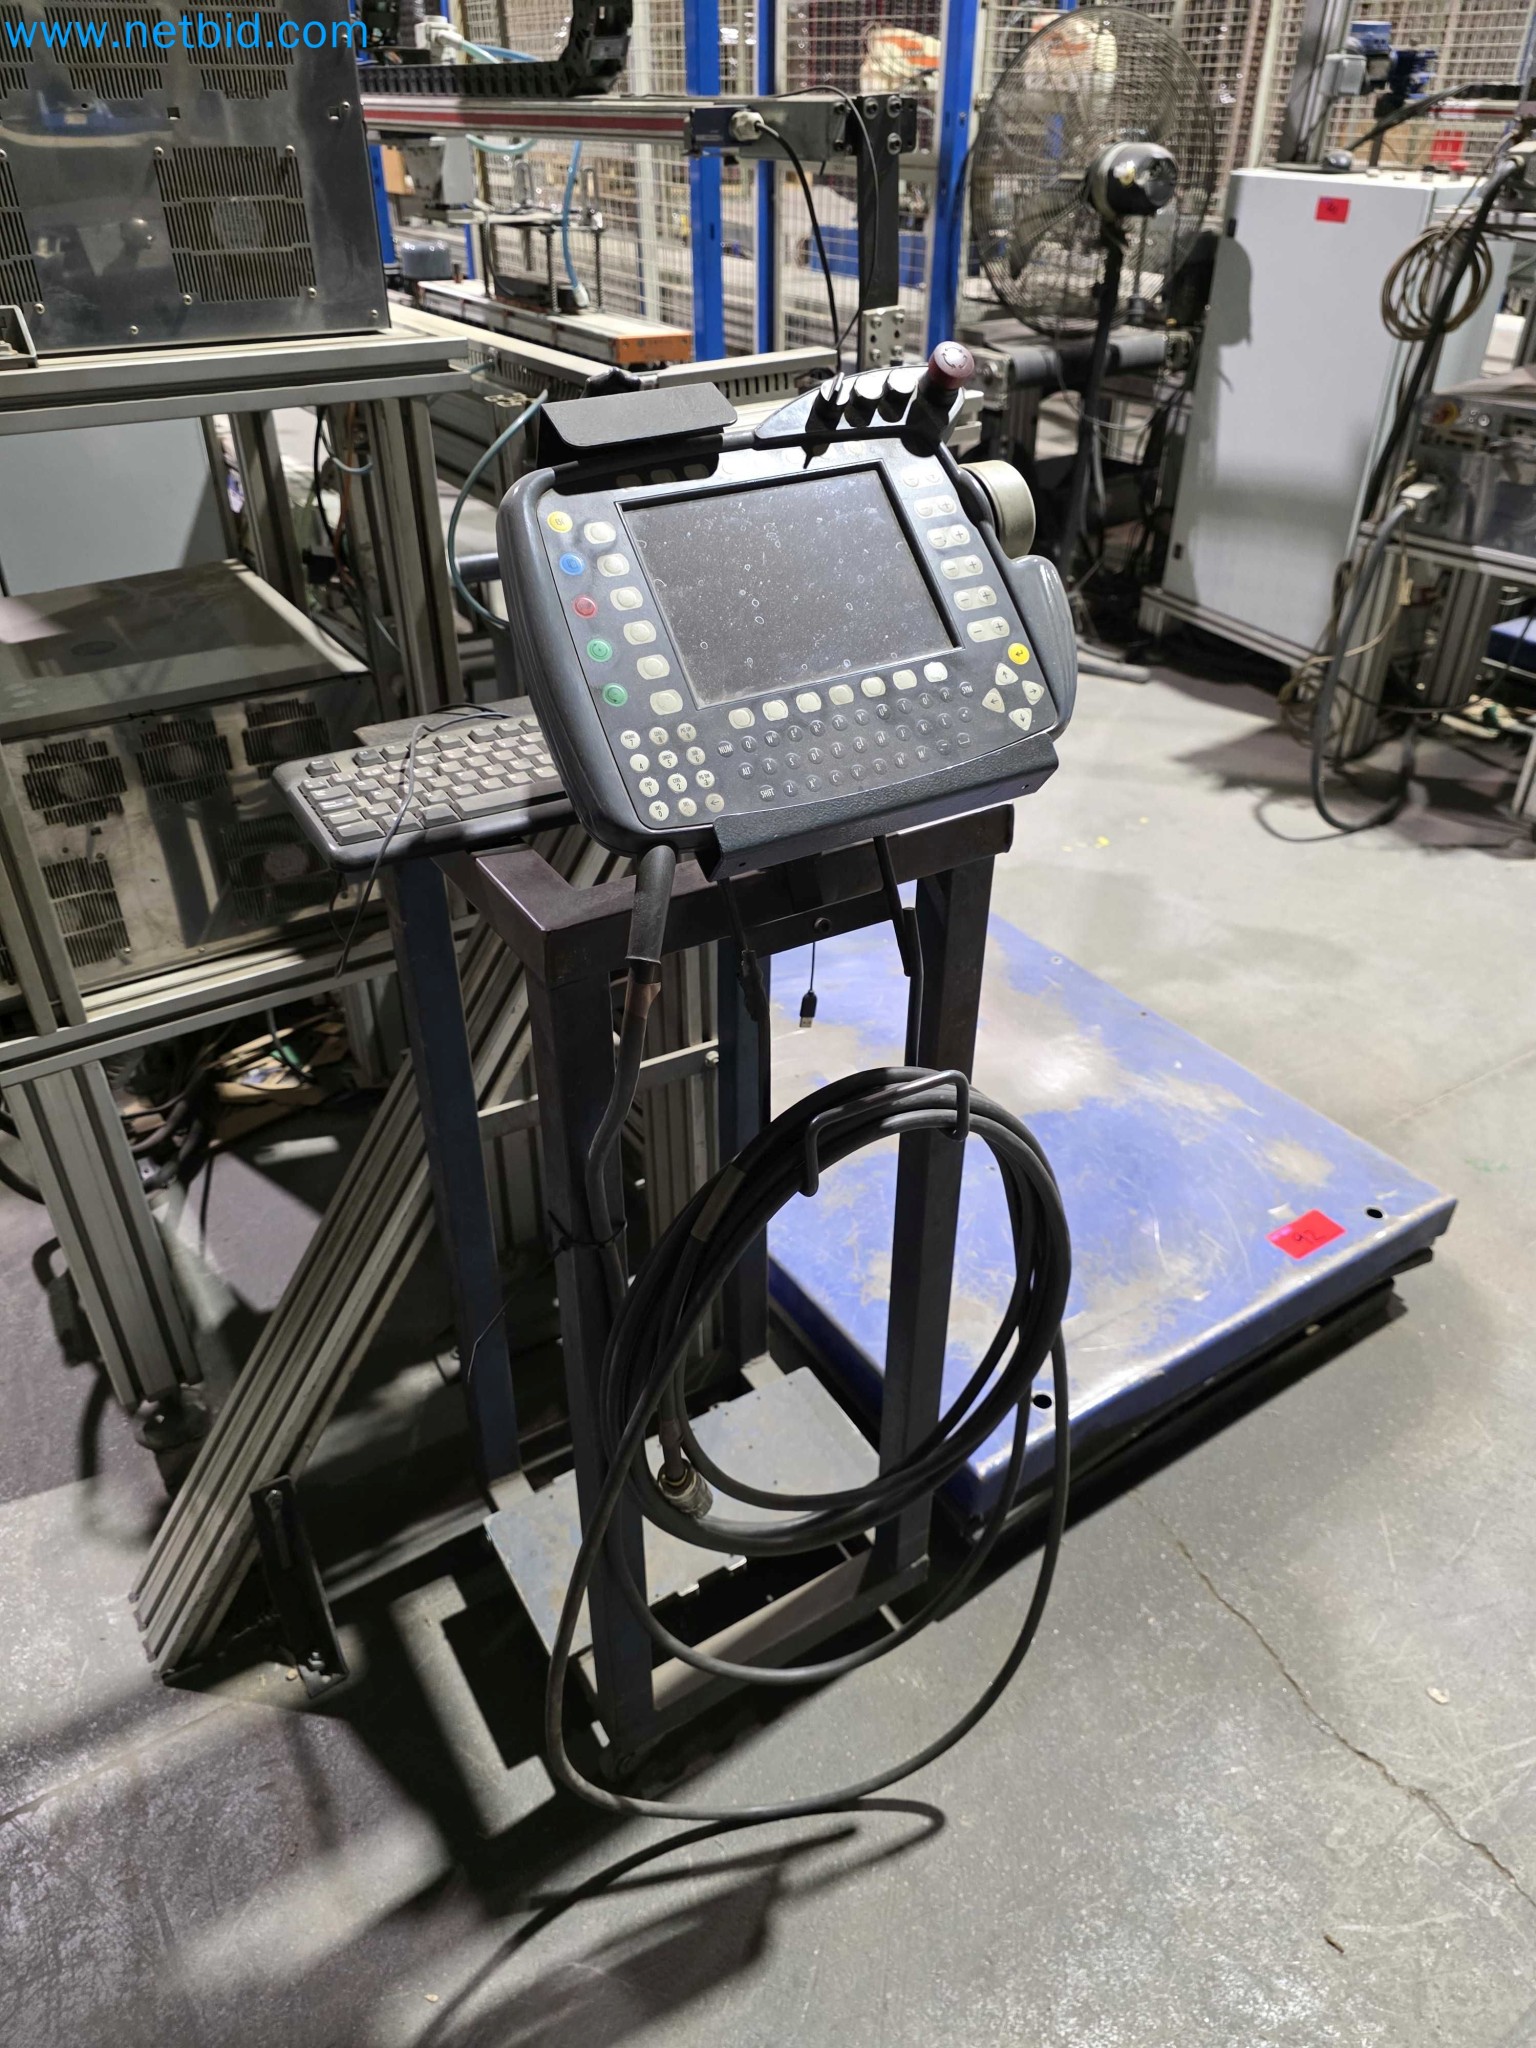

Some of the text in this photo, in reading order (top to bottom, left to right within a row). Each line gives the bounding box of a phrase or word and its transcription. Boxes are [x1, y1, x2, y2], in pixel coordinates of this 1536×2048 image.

[961, 685, 974, 695] SYM
[718, 744, 734, 755] NUM
[742, 766, 751, 776] ALT
[760, 788, 775, 799] SHIFT
